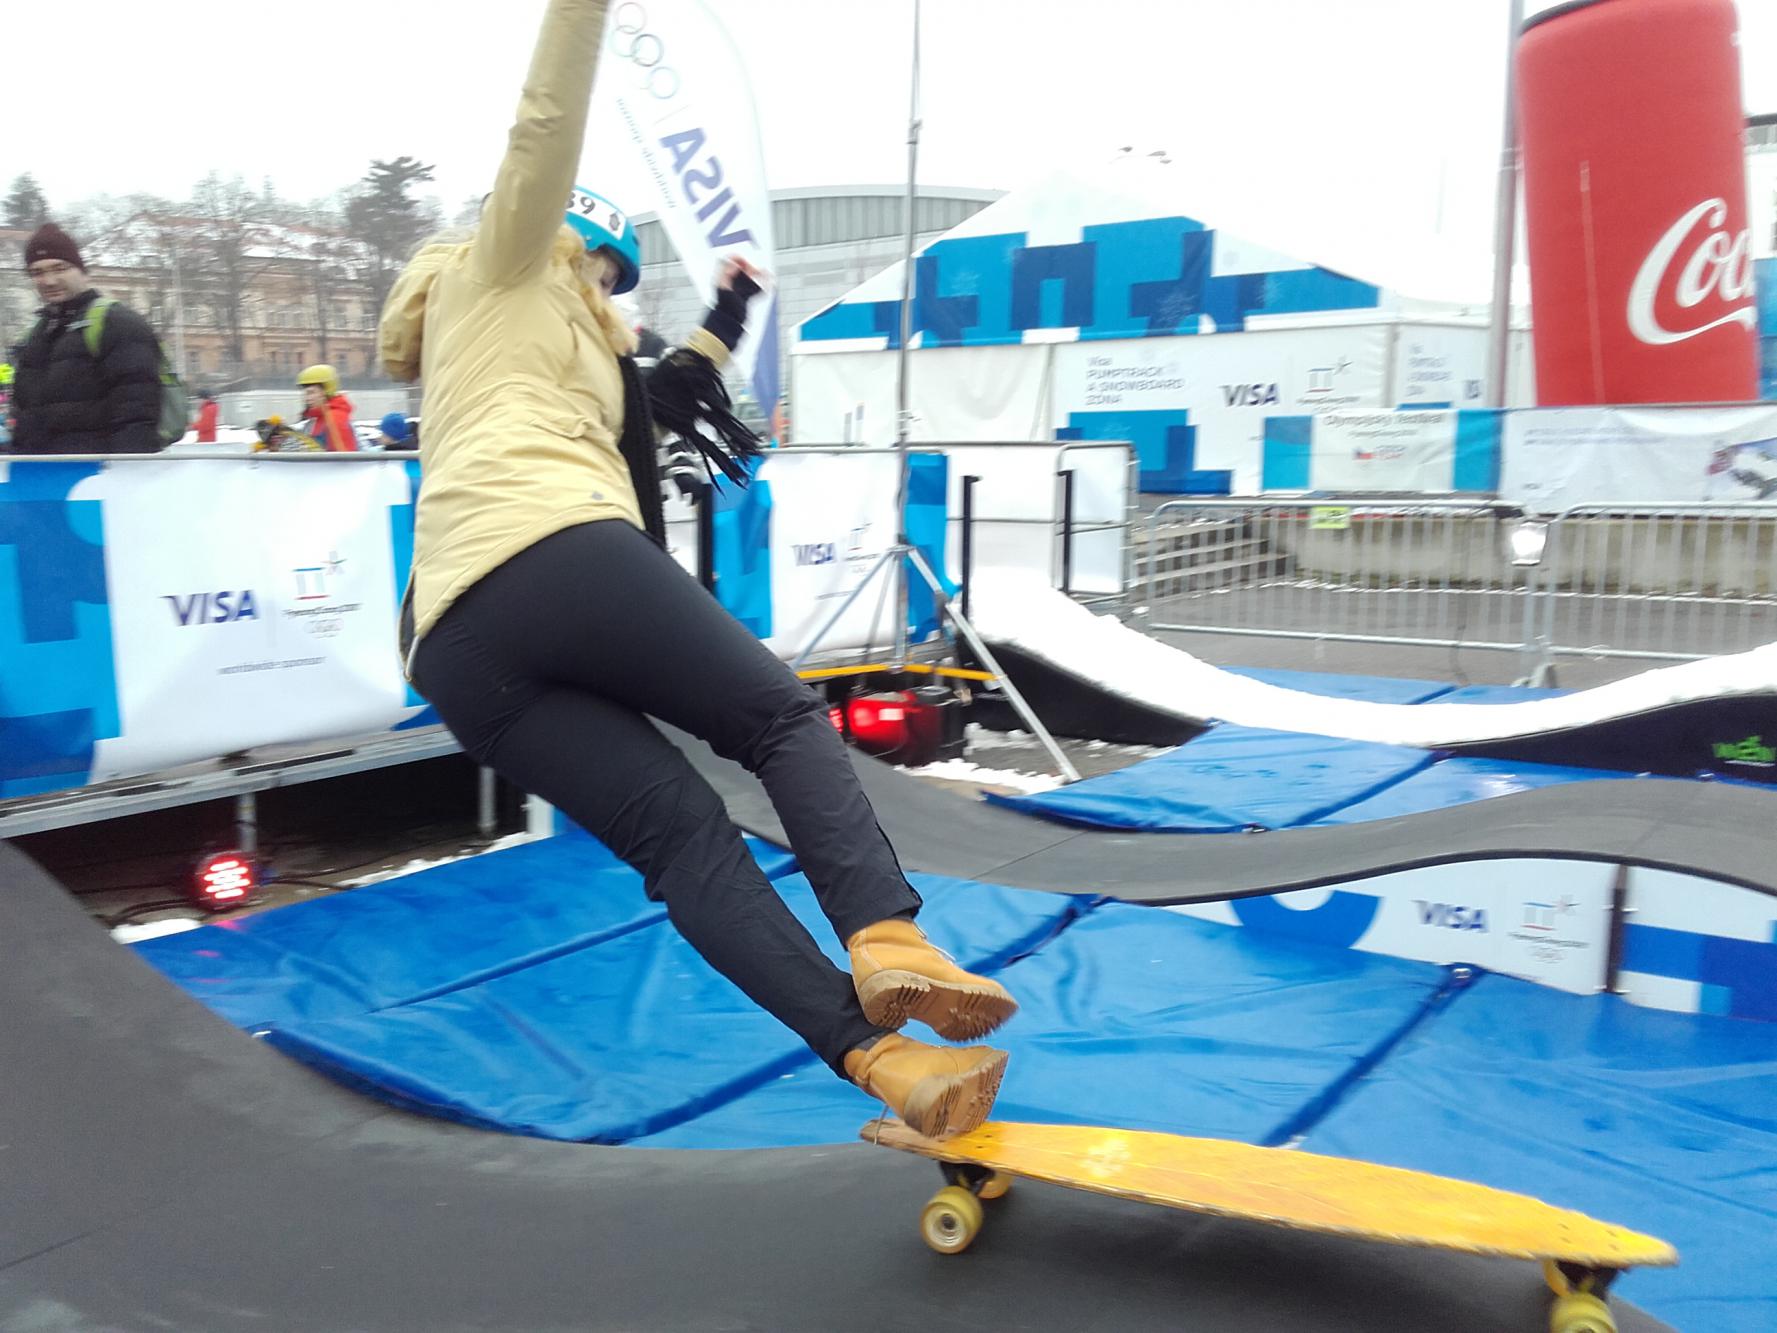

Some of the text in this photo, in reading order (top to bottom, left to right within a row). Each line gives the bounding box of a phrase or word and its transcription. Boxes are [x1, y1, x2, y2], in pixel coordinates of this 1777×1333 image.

[1222, 383, 1280, 407] VISA
[792, 543, 837, 566] VISA
[160, 589, 258, 626] VISA
[1414, 900, 1488, 933] VISA
